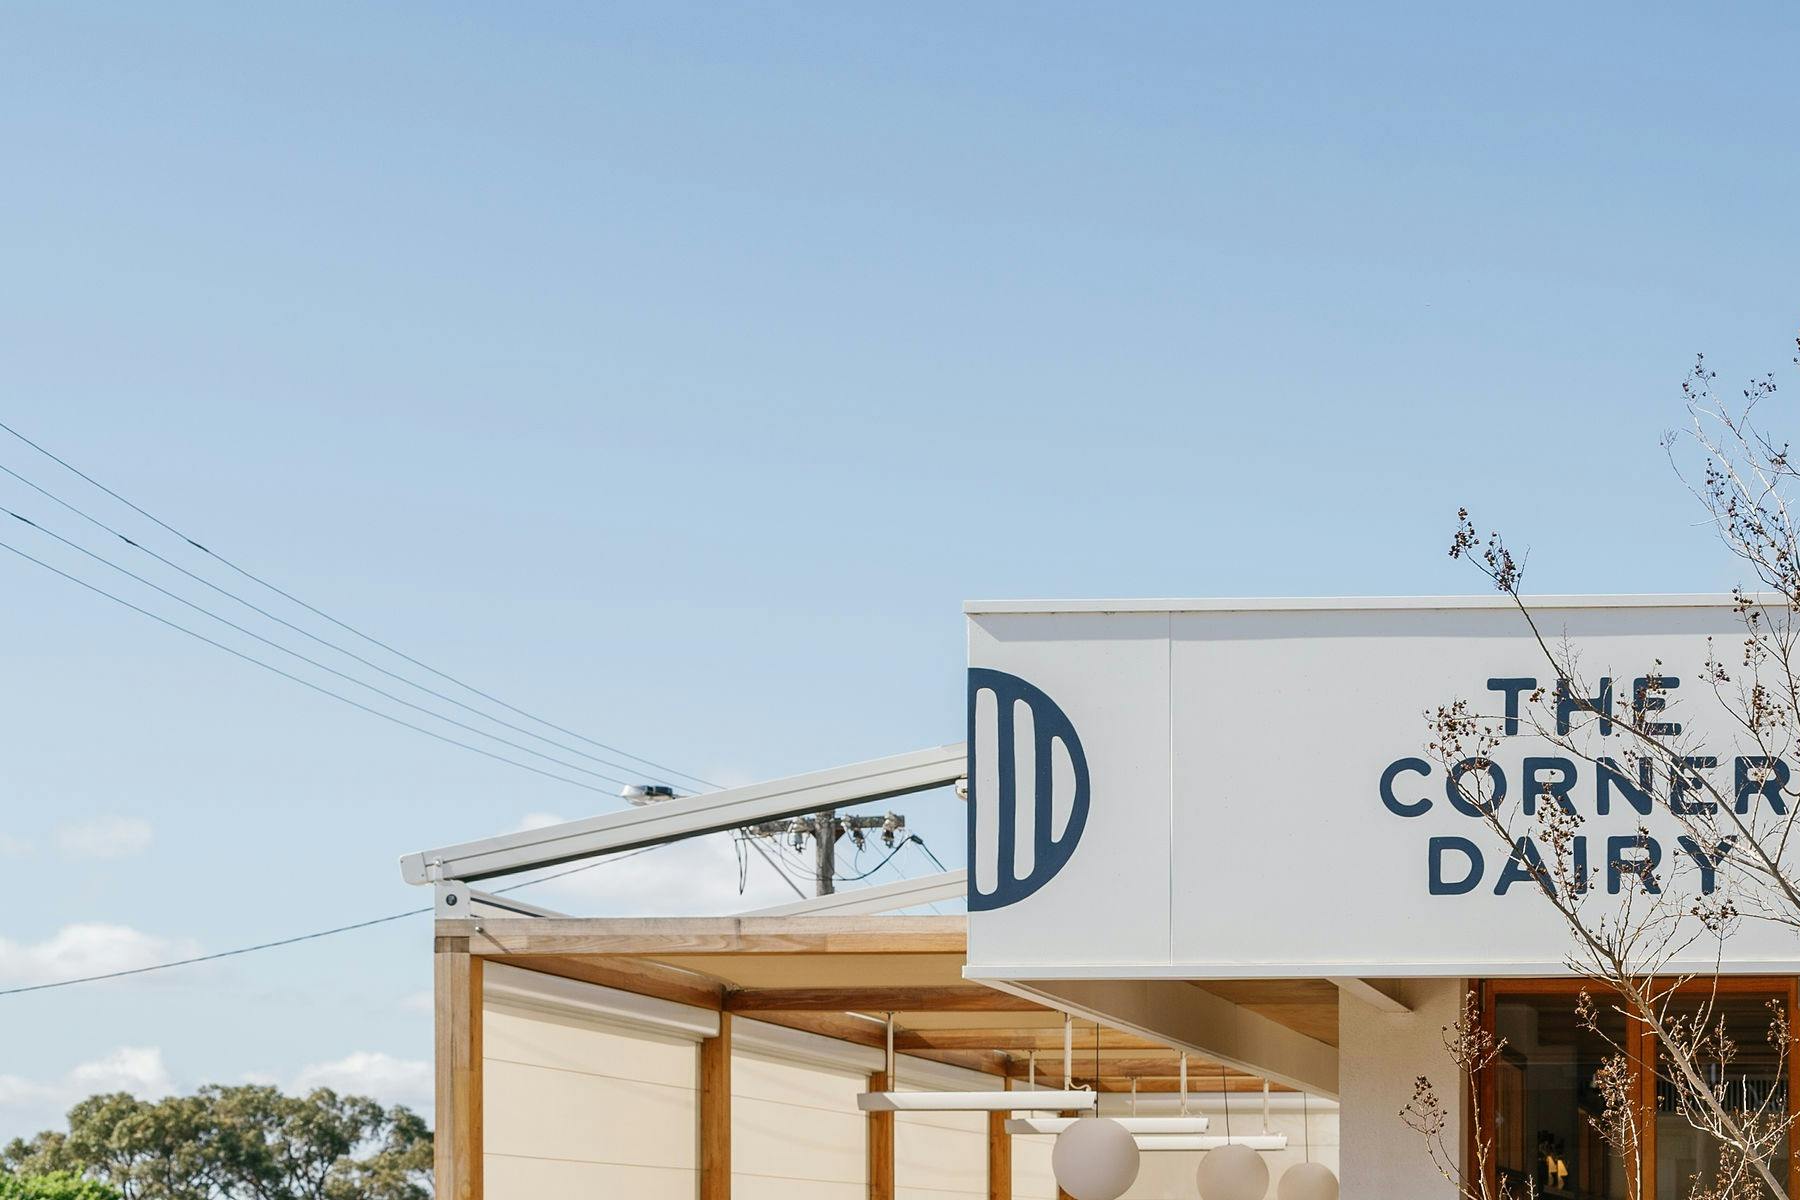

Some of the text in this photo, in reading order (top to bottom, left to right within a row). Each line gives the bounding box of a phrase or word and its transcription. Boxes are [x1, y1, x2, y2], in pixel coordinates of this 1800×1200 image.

[1486, 676, 1682, 737] THE
[1379, 755, 1792, 818] CORNER
[1428, 835, 1738, 896] DAIRY
